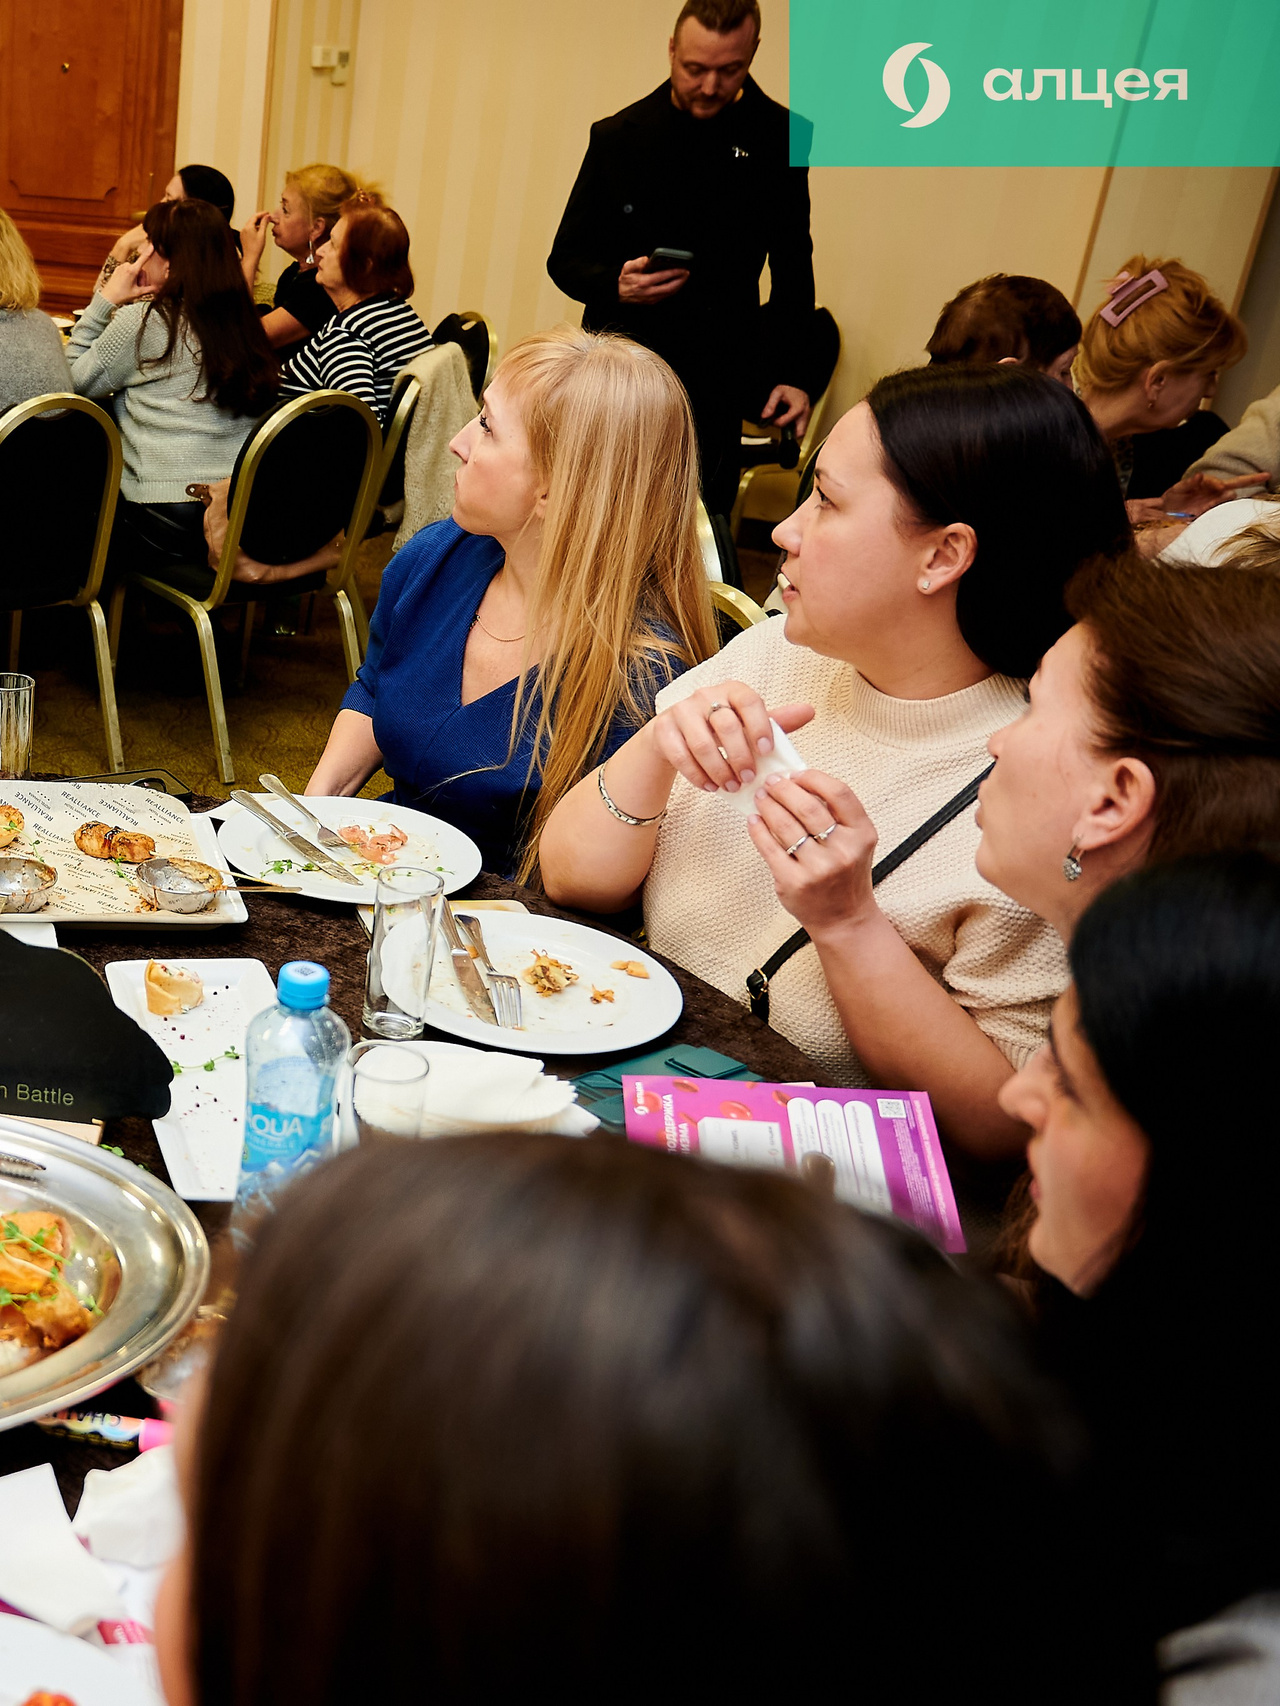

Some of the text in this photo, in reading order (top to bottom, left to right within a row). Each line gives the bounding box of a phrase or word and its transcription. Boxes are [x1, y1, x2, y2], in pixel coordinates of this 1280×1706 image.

[14, 791, 54, 822] REALLIANCE
[60, 790, 101, 819] REALLIANCE
[99, 798, 139, 827] REALLIANCE
[145, 797, 186, 825] REALLIANCE
[33, 822, 73, 844] REALLIANCE
[17, 1083, 74, 1106] Battle
